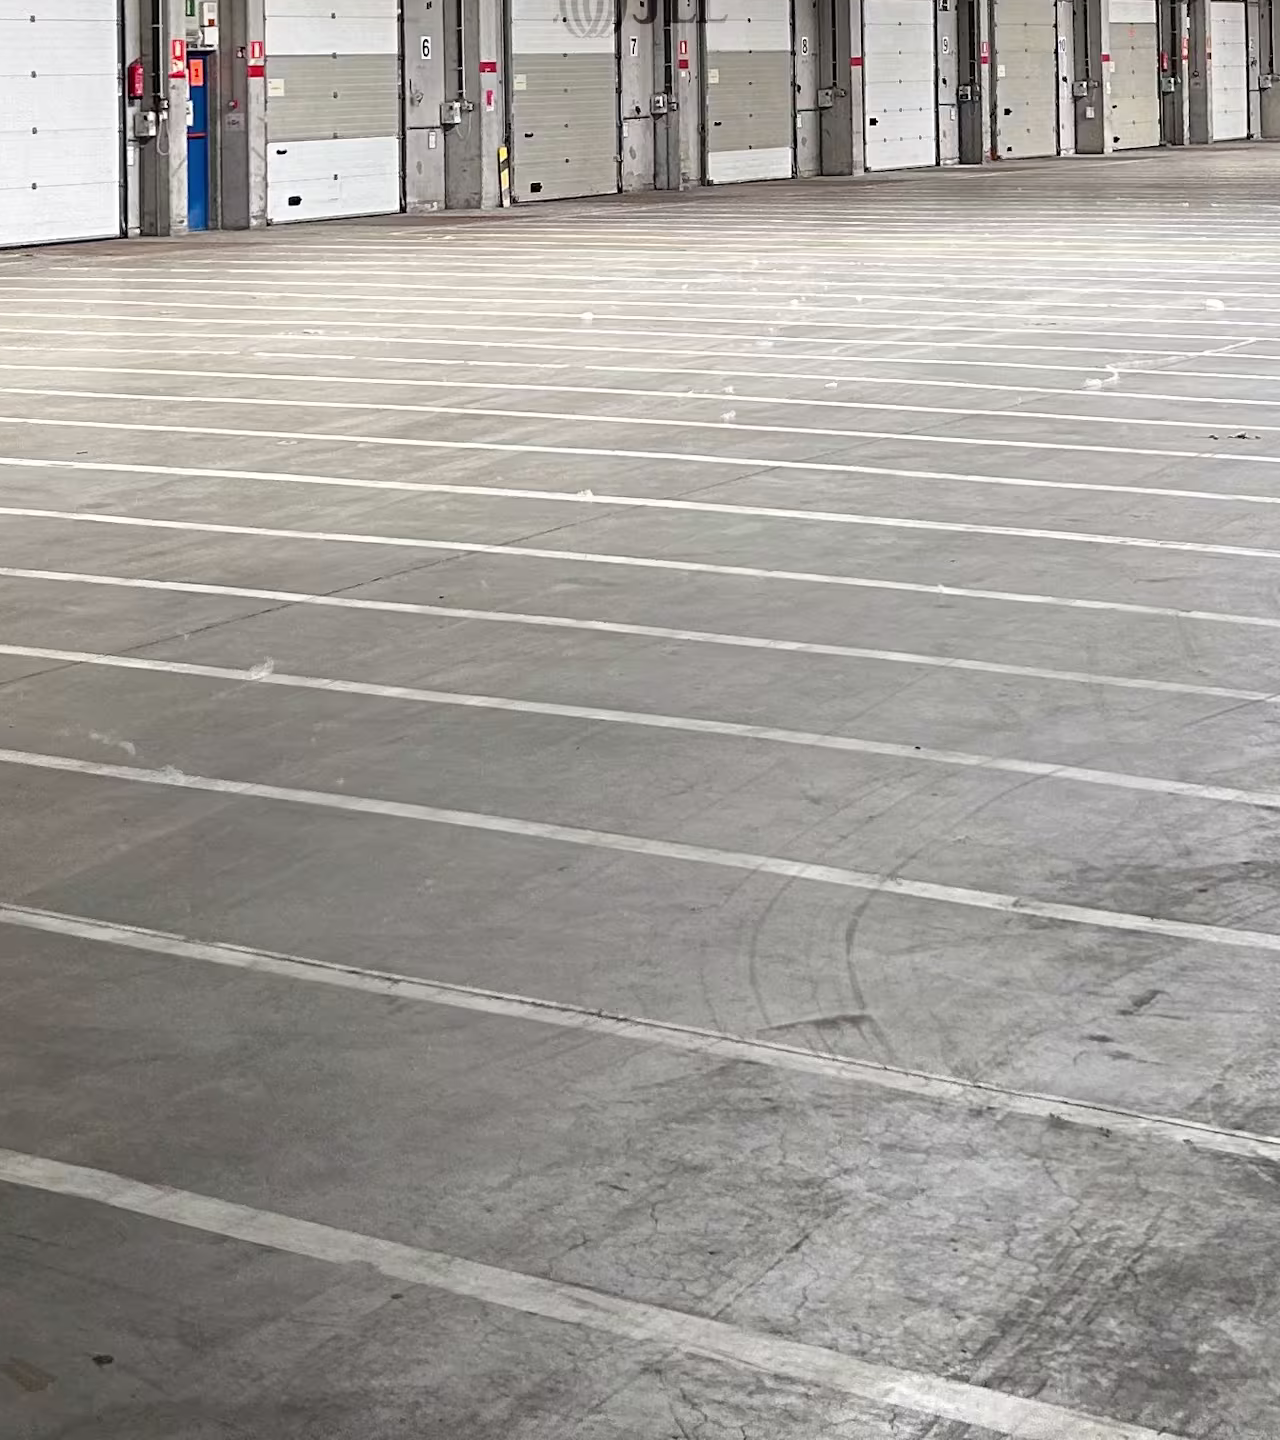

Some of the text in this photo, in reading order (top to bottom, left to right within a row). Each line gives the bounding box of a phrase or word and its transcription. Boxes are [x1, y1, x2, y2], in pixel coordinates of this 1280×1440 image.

[422, 38, 430, 57] 6
[630, 38, 637, 55] 7
[802, 38, 808, 54] 8
[943, 38, 948, 52] 9
